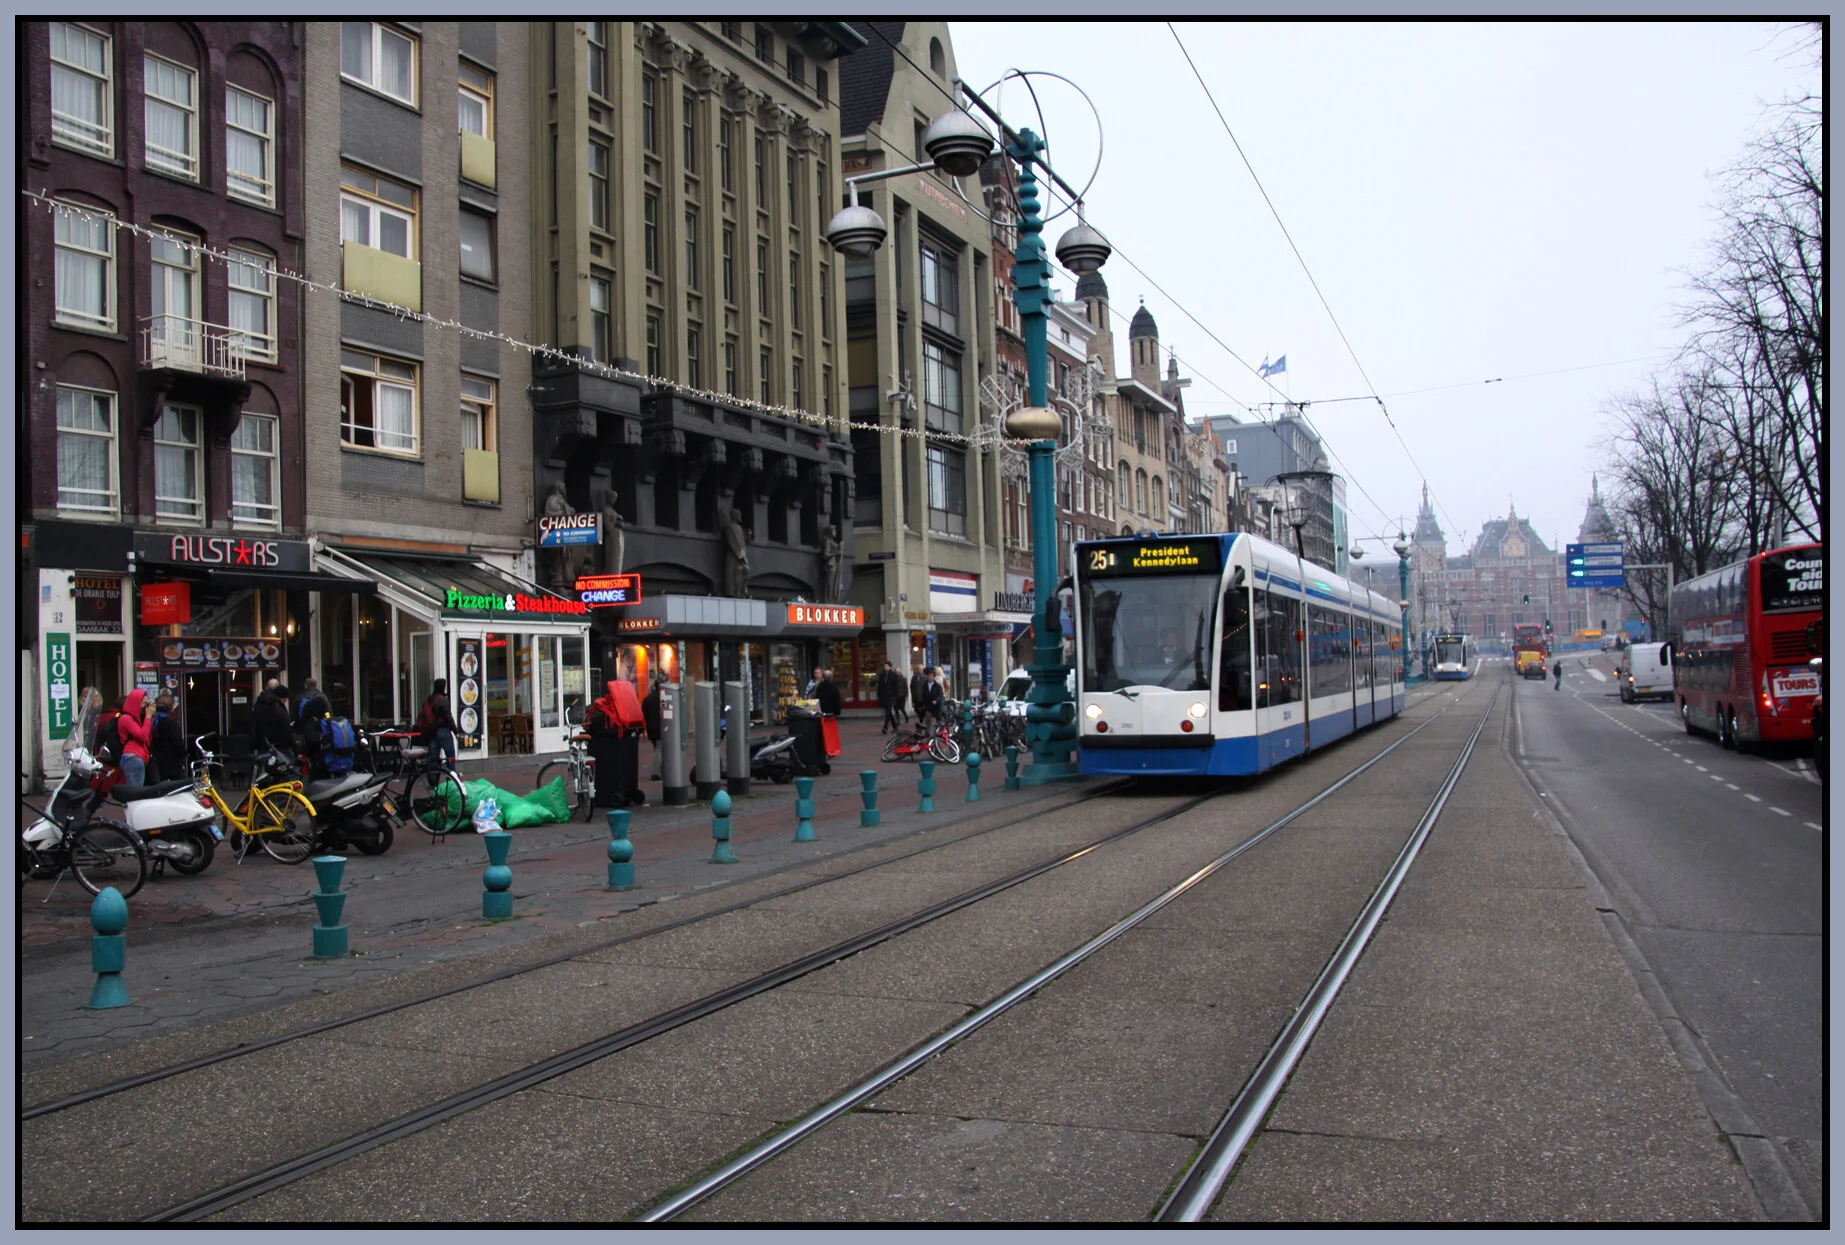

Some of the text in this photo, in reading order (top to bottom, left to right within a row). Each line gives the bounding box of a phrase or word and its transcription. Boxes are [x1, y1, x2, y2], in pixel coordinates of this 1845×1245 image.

[540, 514, 596, 530] CHANGE
[1140, 546, 1190, 557] President
[1090, 550, 1107, 570] 25
[1133, 556, 1199, 567] Kennedylaan
[75, 577, 120, 589] HOTEL
[575, 578, 631, 590] NO COMMISSION
[446, 590, 504, 611] Pizzeria
[515, 593, 587, 614] Steakhouse
[581, 590, 626, 602] CHANGE
[796, 607, 857, 624] BLOKKER
[618, 618, 660, 629] BLOKKER
[1777, 678, 1817, 691] TOURS
